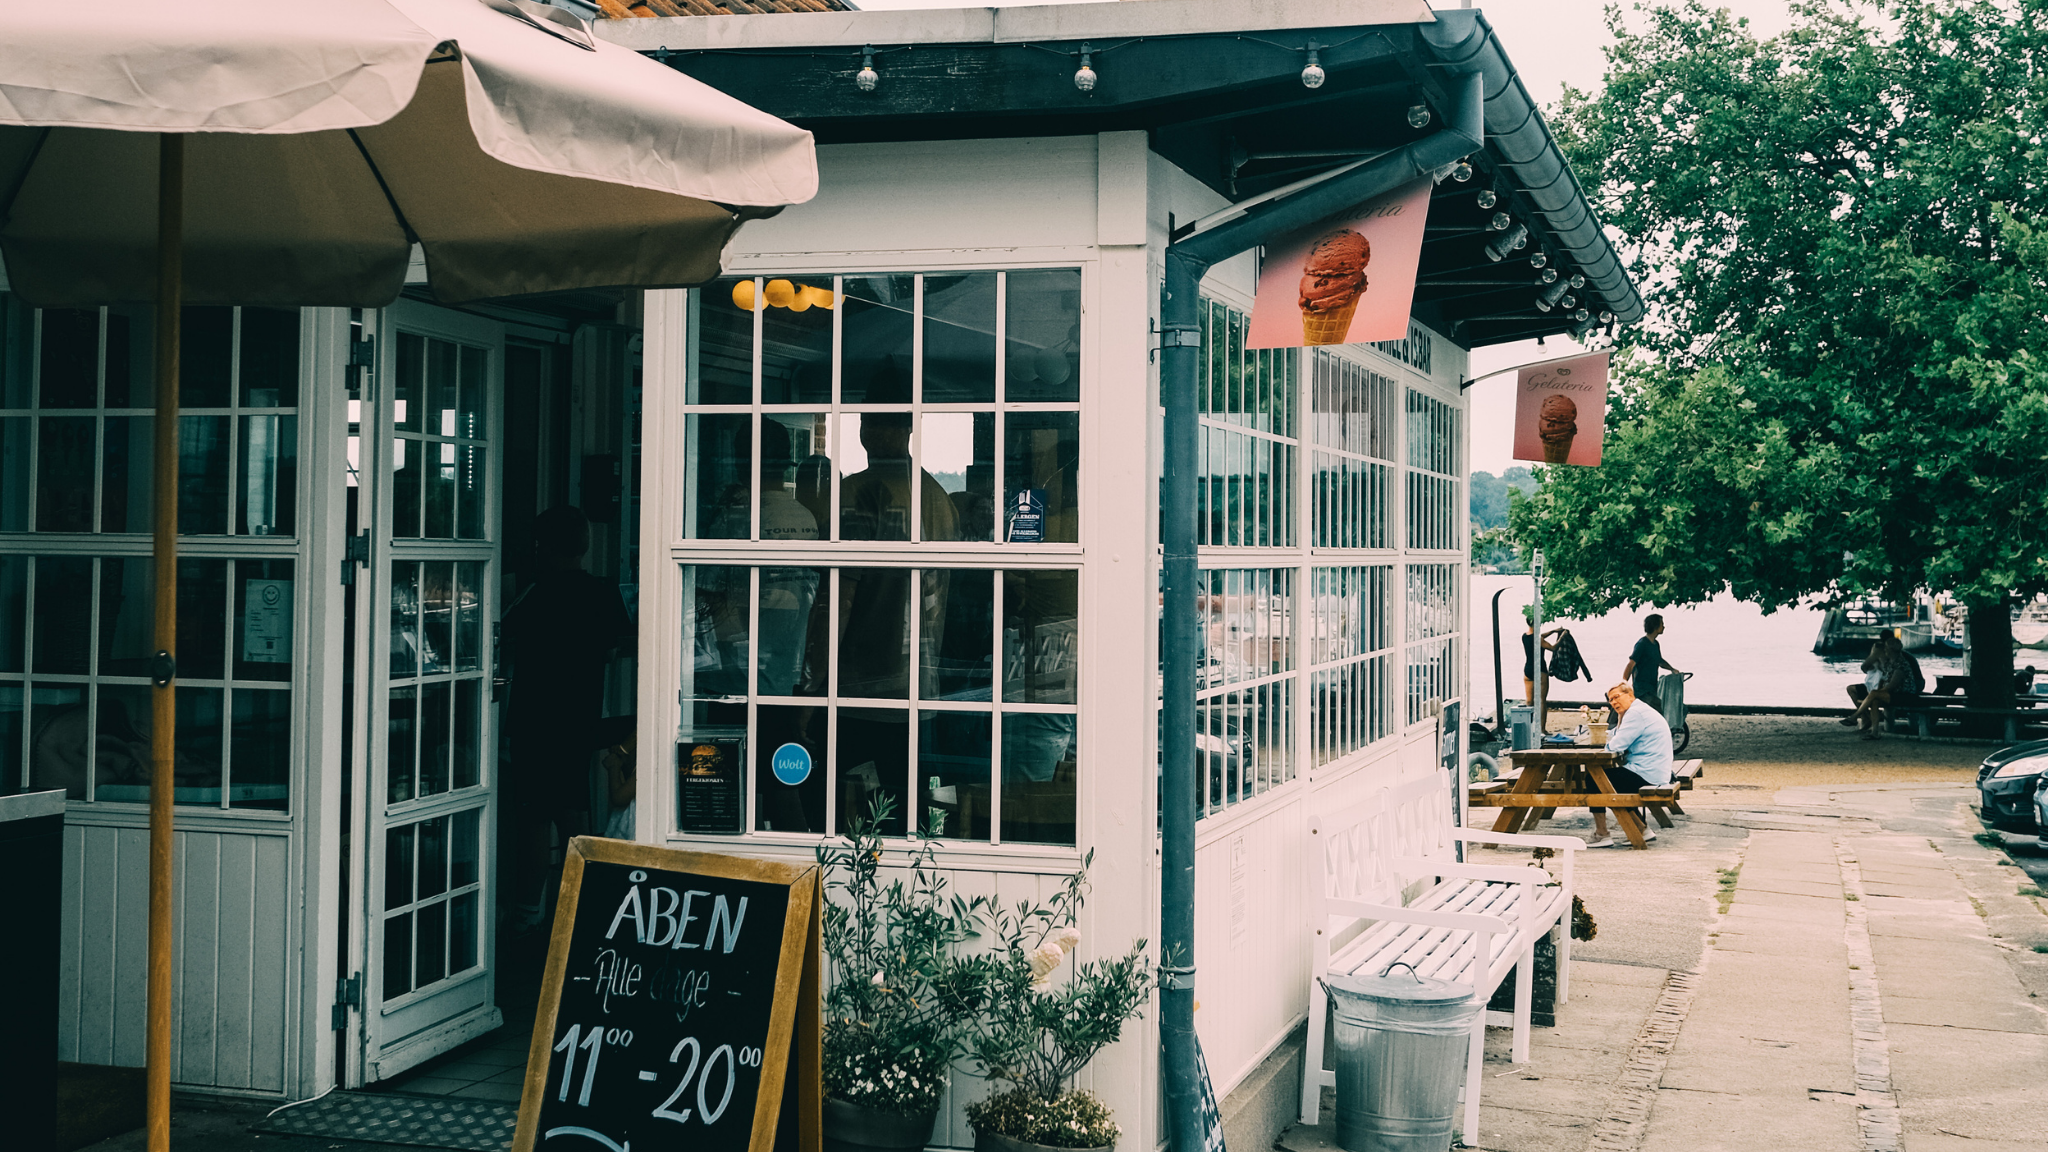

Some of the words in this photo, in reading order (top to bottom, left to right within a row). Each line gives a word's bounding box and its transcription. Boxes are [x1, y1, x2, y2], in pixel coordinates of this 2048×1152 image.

[1411, 326, 1432, 375] ISBAR
[1526, 372, 1594, 392] Gelateria
[764, 527, 797, 535] TOUR
[778, 758, 805, 770] Wolt
[605, 869, 749, 954] ÅBEN
[594, 948, 642, 1013] Alle
